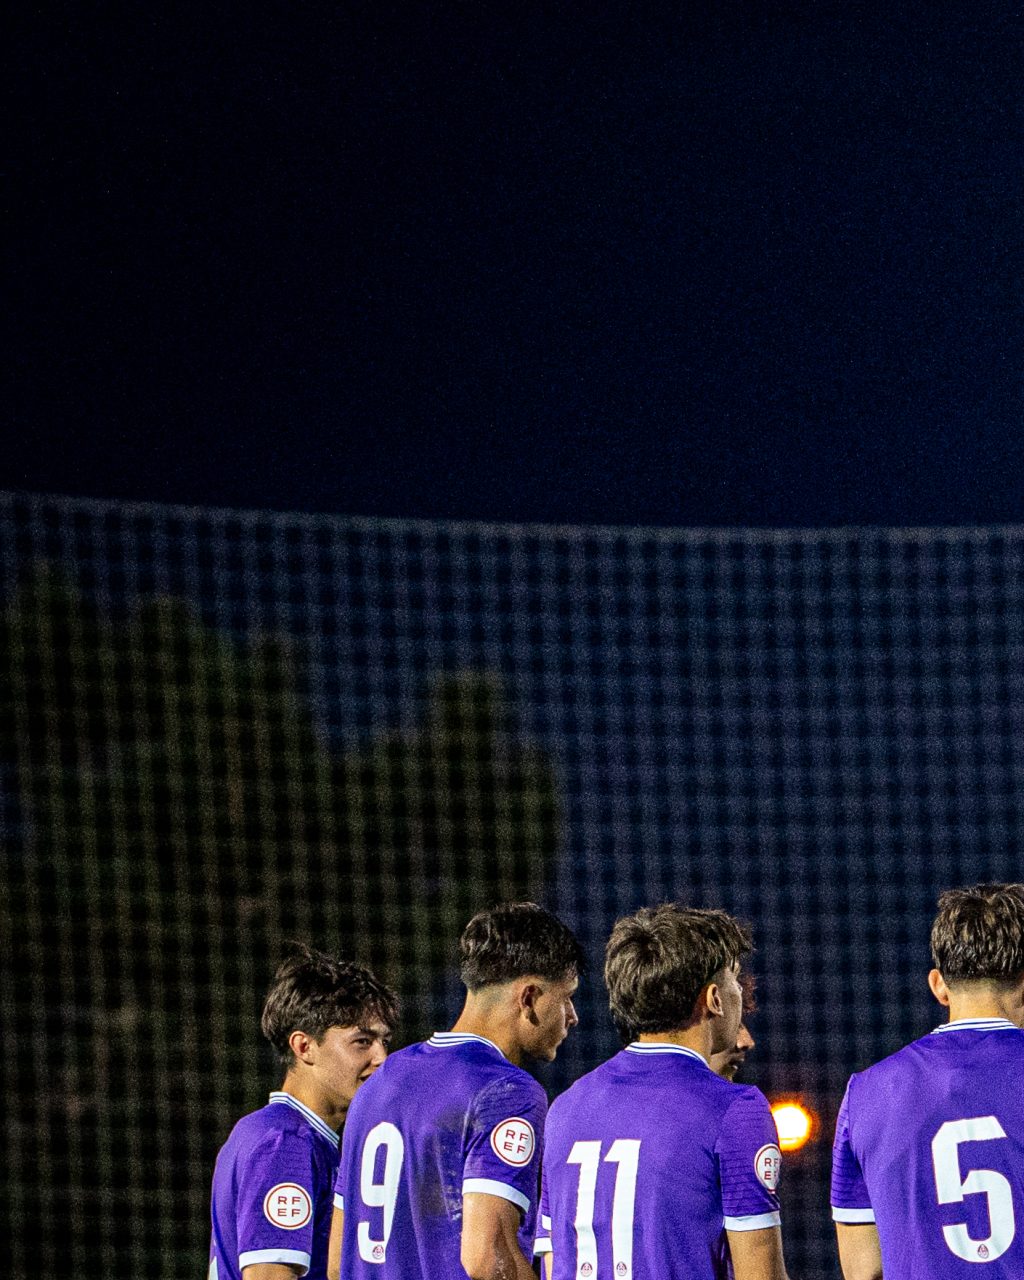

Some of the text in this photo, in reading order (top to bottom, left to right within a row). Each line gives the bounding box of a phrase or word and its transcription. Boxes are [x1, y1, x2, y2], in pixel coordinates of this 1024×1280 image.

[505, 1129, 529, 1141] RF
[503, 1141, 526, 1153] EF
[357, 1121, 404, 1264] 9
[931, 1115, 1016, 1263] 5
[277, 1195, 302, 1205] RF
[277, 1208, 301, 1217] EF
